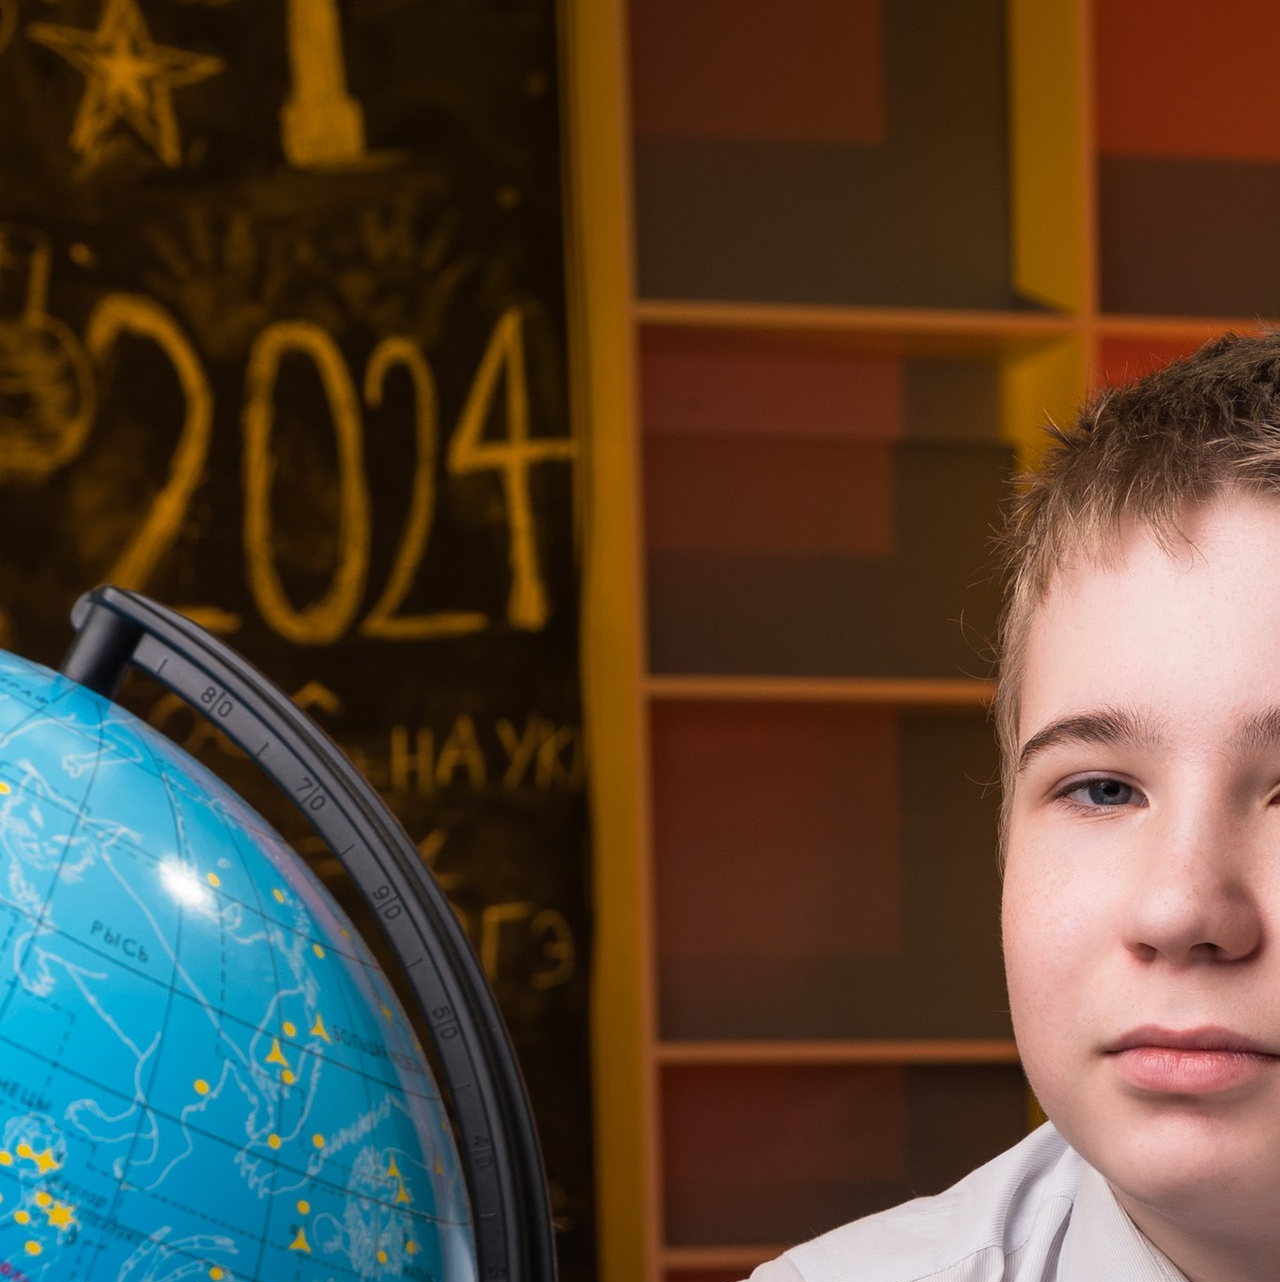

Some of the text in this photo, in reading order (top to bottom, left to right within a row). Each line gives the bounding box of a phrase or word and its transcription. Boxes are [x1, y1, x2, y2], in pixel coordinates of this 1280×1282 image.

[87, 291, 578, 645] 2024
[200, 685, 235, 718] 80
[295, 776, 327, 813] 70
[90, 919, 149, 964] РЫСЬ
[457, 900, 576, 991] ГЭ
